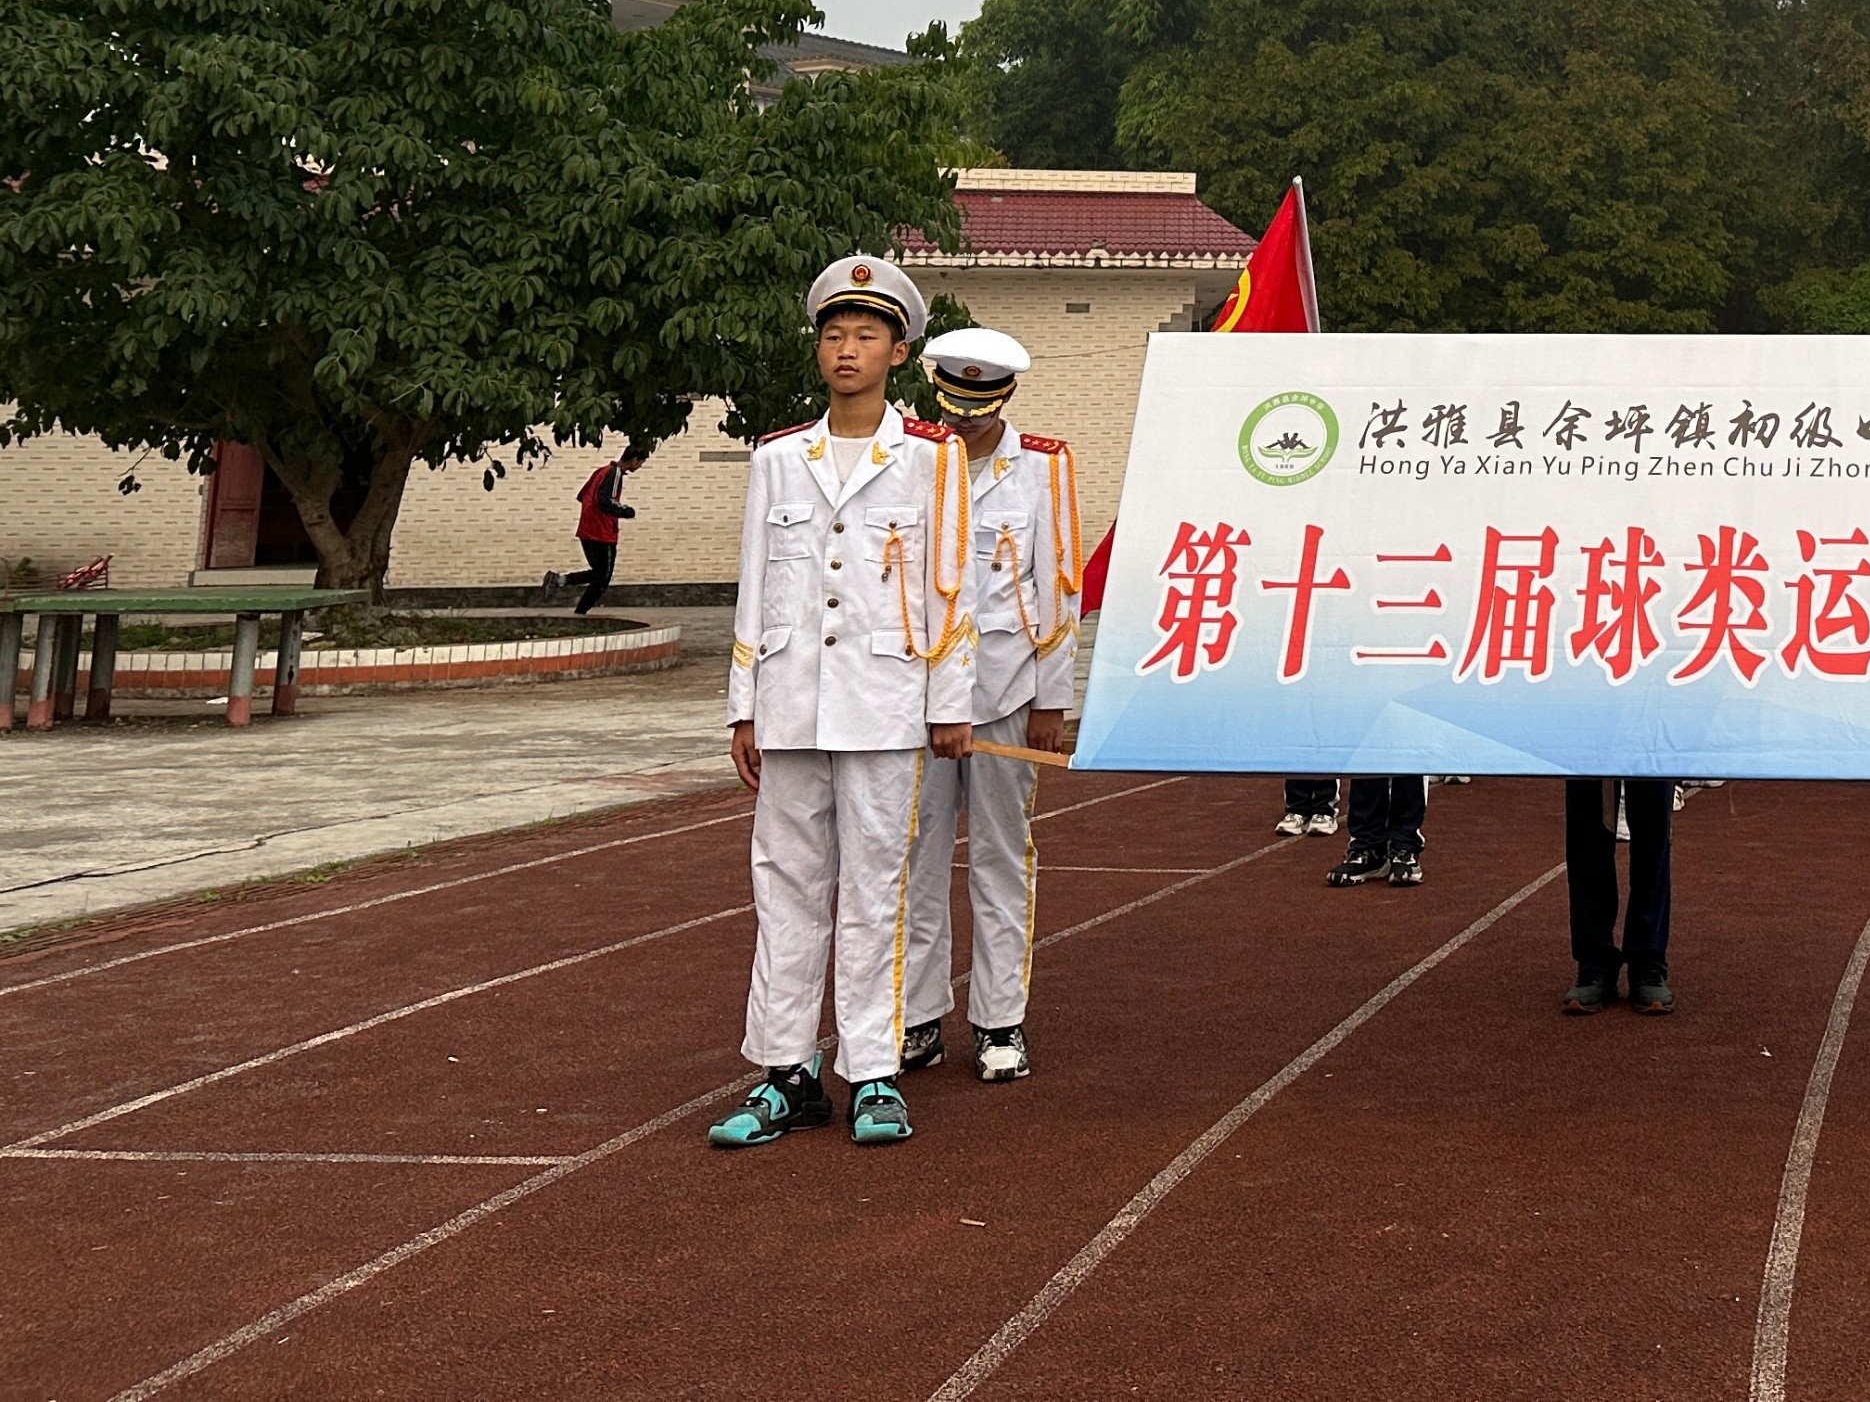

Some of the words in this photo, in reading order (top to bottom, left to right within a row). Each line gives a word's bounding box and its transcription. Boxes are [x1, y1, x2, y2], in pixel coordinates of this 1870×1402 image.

[1359, 455, 1430, 481] Hong
[1440, 455, 1466, 475] Ya
[1474, 455, 1532, 476] Xian
[1542, 455, 1571, 476] Yu
[1581, 455, 1639, 481] Ping
[1647, 456, 1714, 477] Zhen
[1723, 456, 1773, 477] Chu
[1782, 456, 1801, 478] Ji
